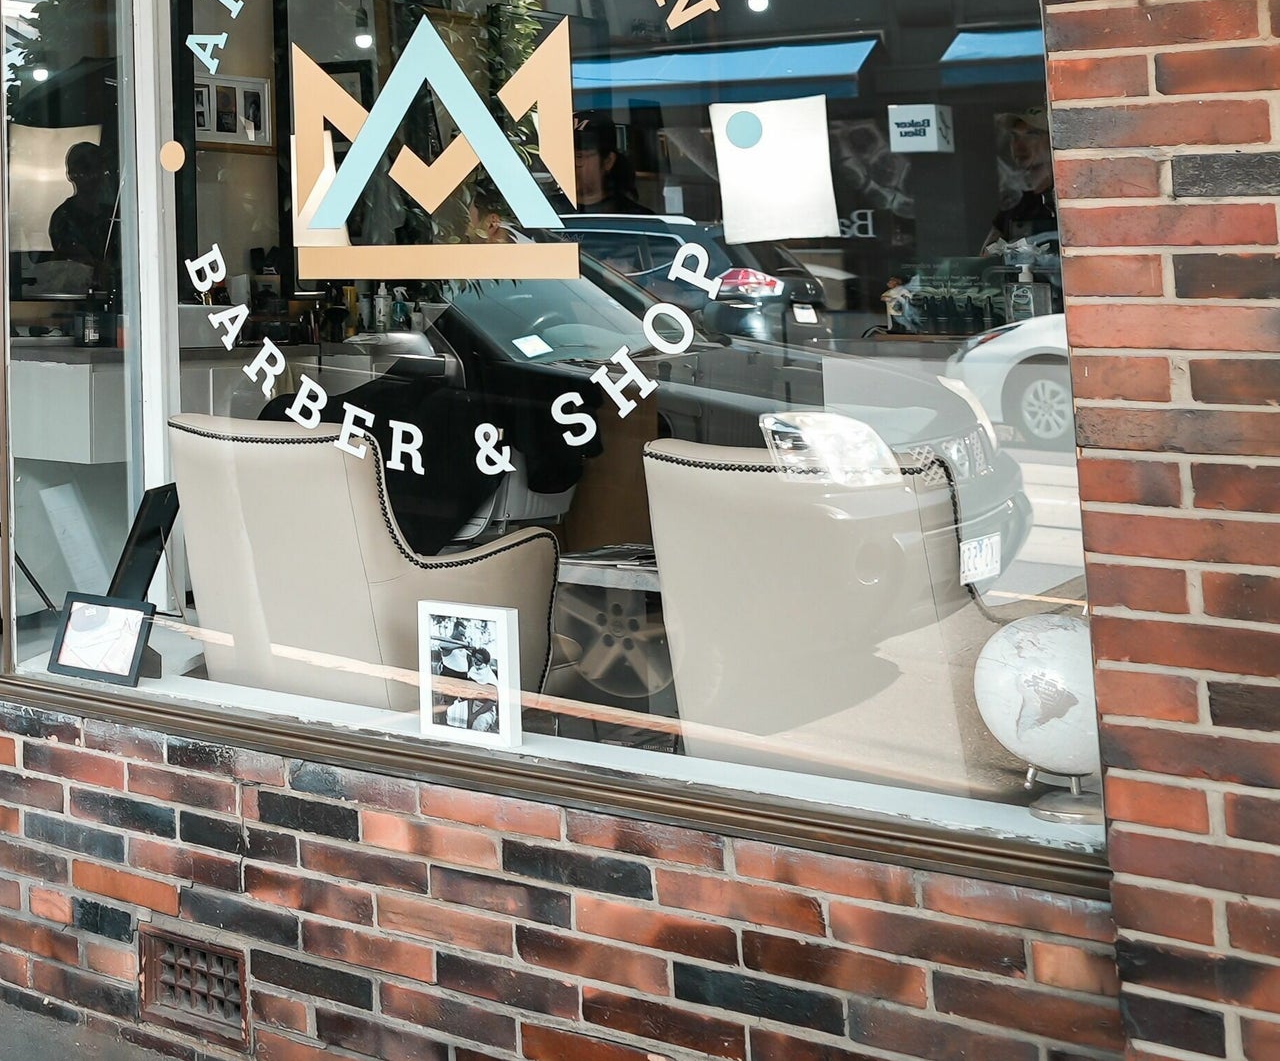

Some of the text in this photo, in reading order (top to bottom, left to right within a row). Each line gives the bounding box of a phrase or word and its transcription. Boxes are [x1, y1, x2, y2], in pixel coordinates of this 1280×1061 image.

[185, 242, 723, 475] BARBER & SHOP
